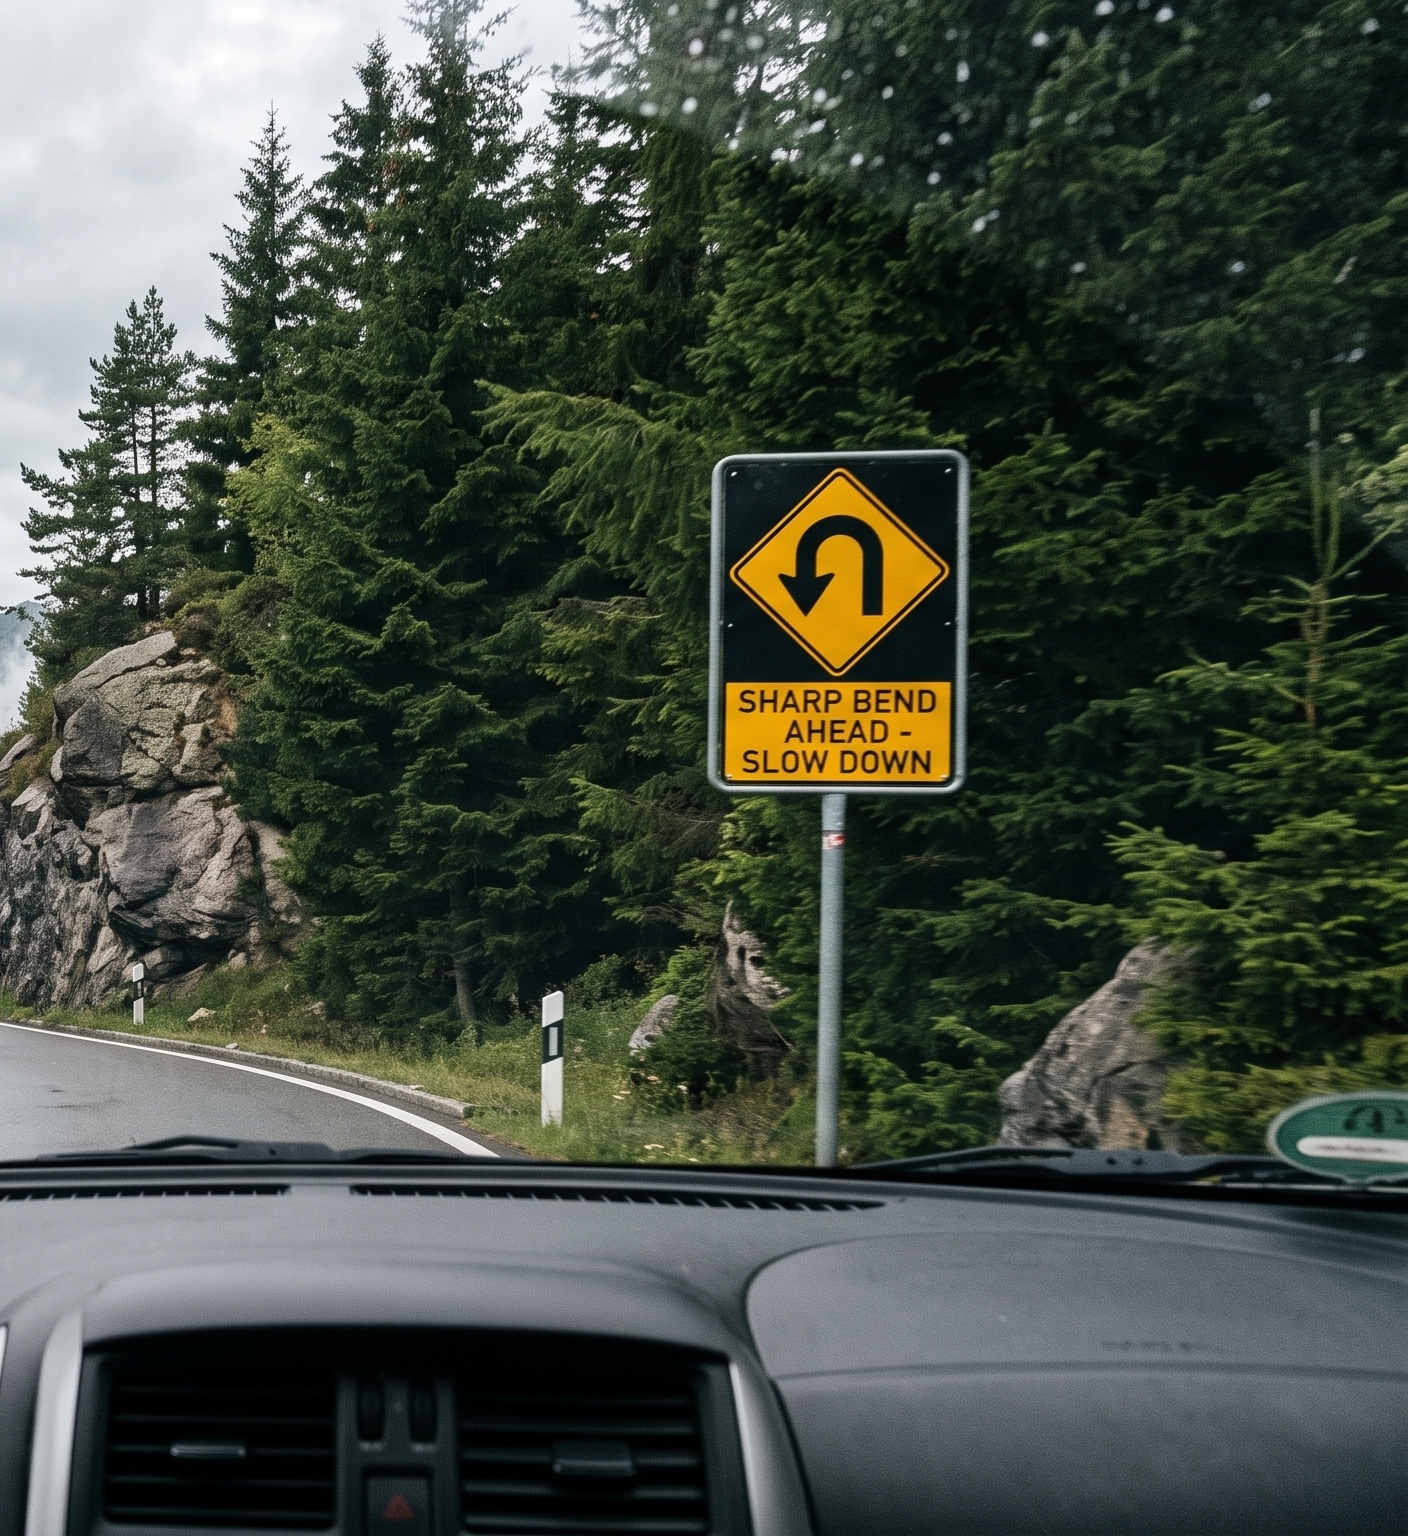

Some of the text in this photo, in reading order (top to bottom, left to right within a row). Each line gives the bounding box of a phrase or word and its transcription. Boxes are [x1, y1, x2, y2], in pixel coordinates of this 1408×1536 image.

[738, 689, 936, 713] SHARP BEND
[784, 719, 888, 744] AHEAD
[742, 749, 931, 774] SLOW DOWN
